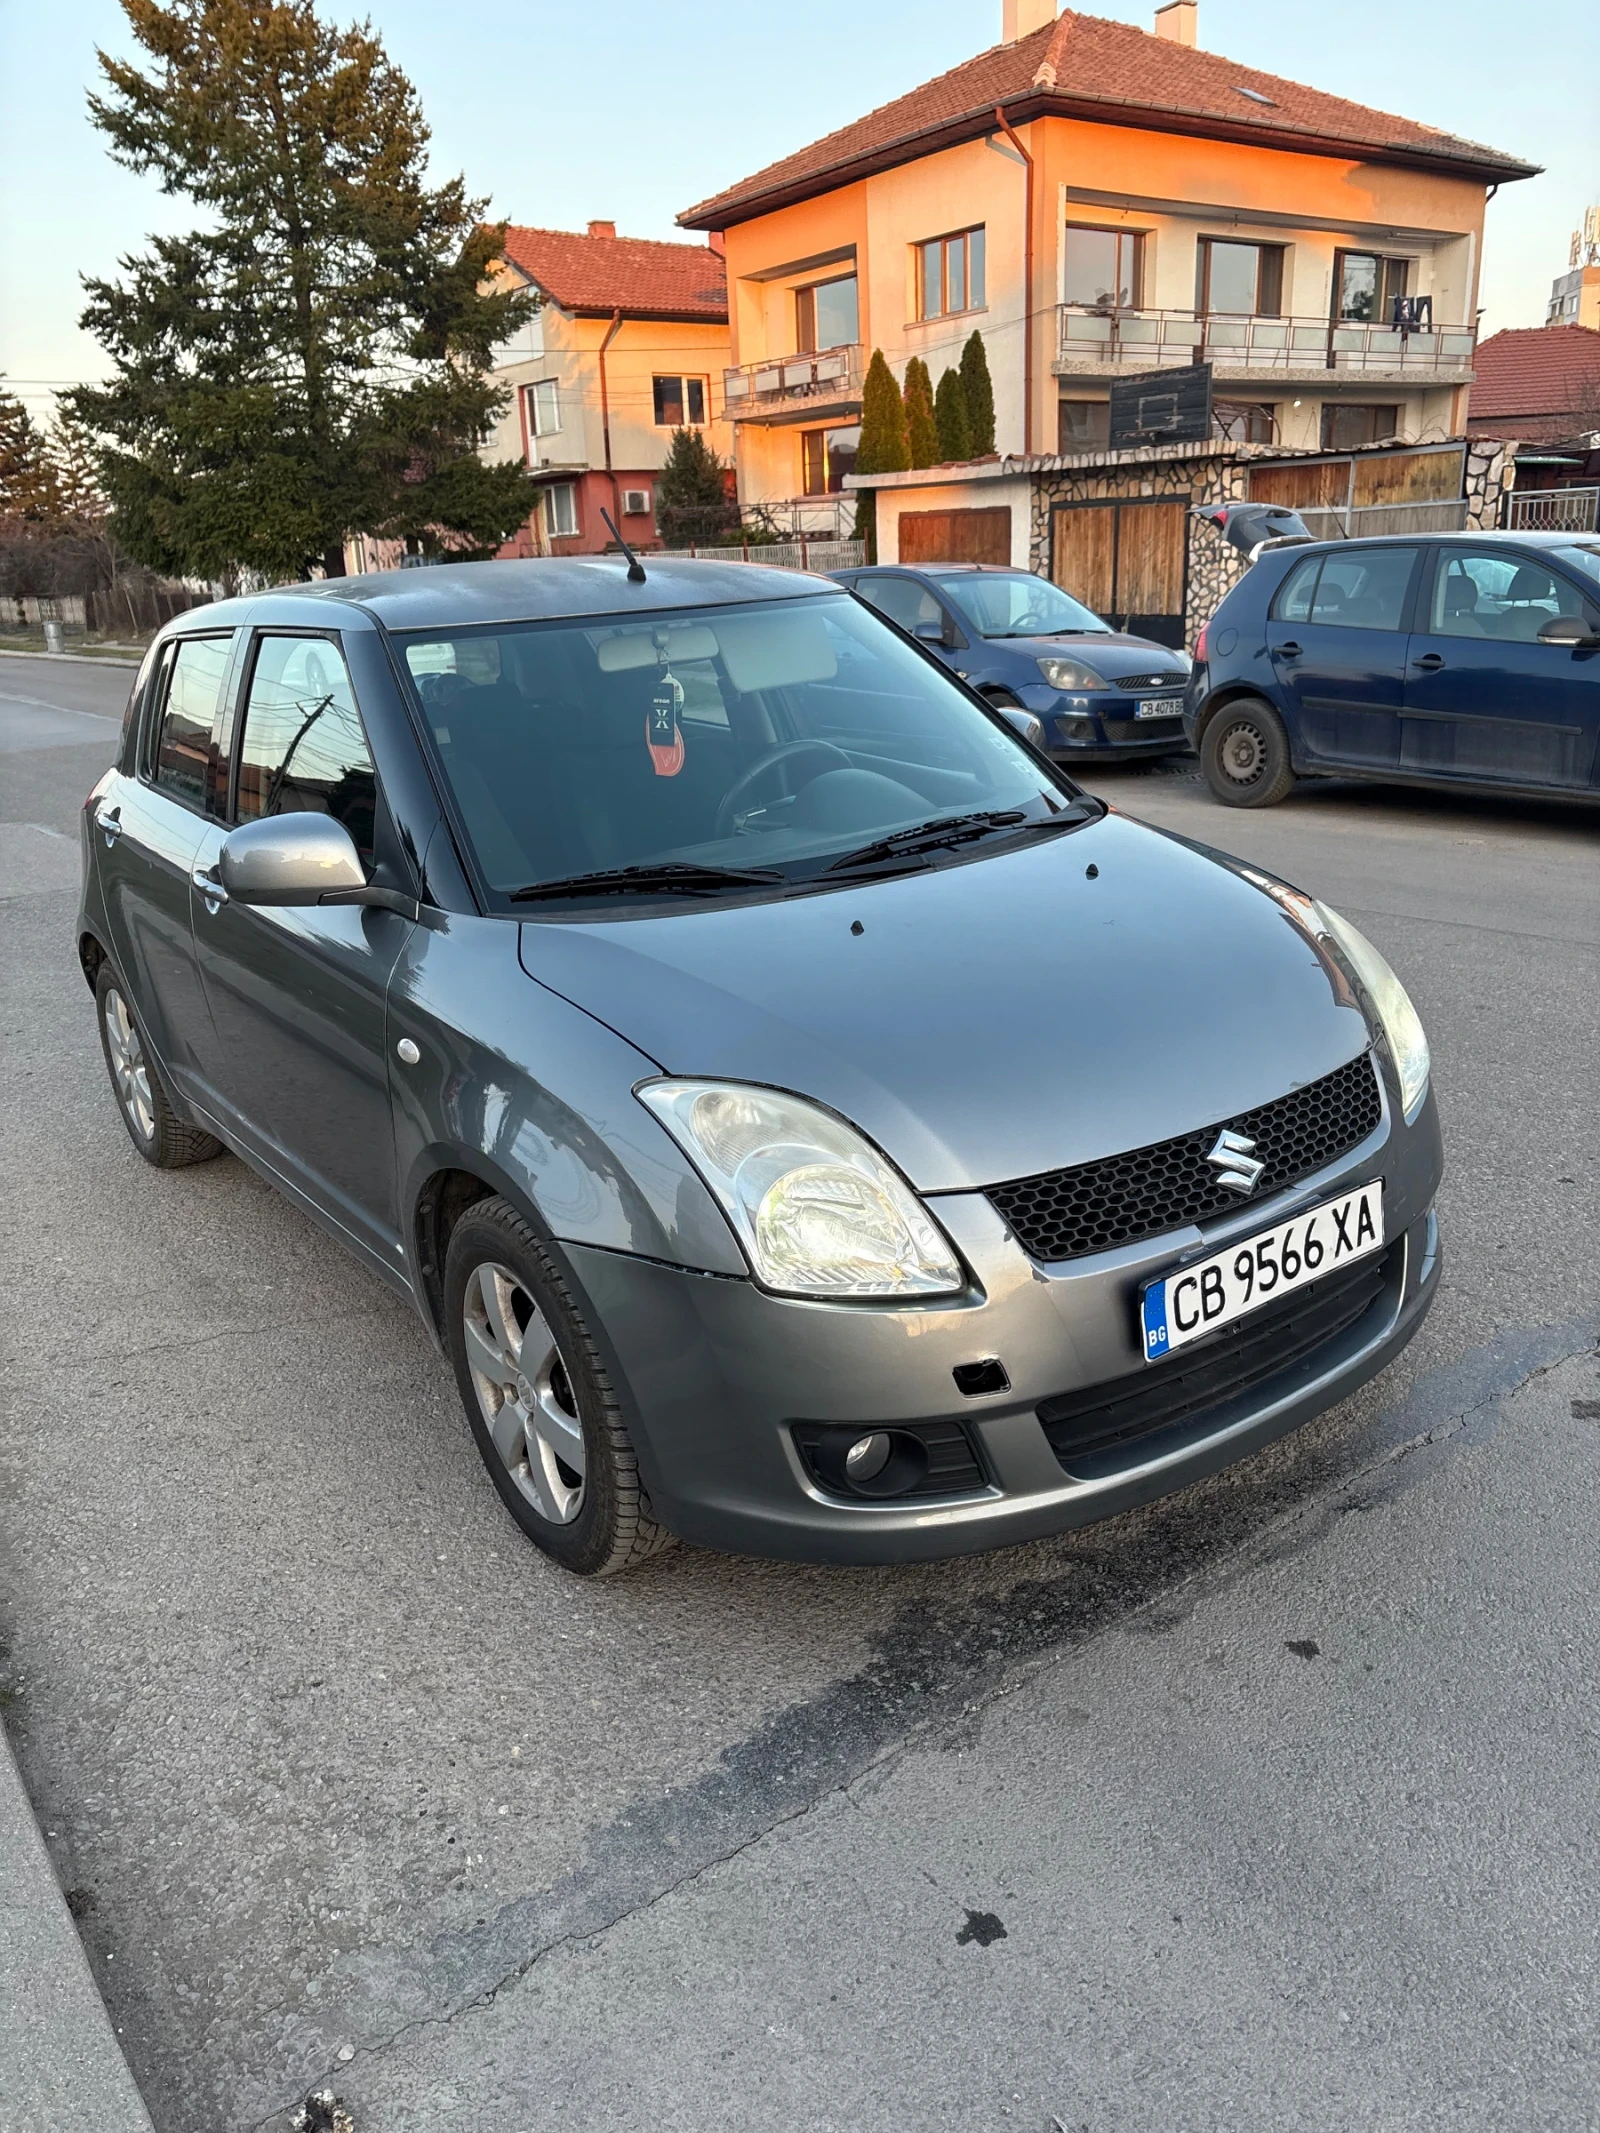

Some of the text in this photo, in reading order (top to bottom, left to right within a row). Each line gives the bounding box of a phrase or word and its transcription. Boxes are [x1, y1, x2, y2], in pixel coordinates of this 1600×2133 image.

[1141, 703, 1153, 715] CB
[1155, 702, 1174, 714] 4078
[1173, 1194, 1376, 1332] CB 9566 XA
[1148, 1325, 1167, 1347] BG
